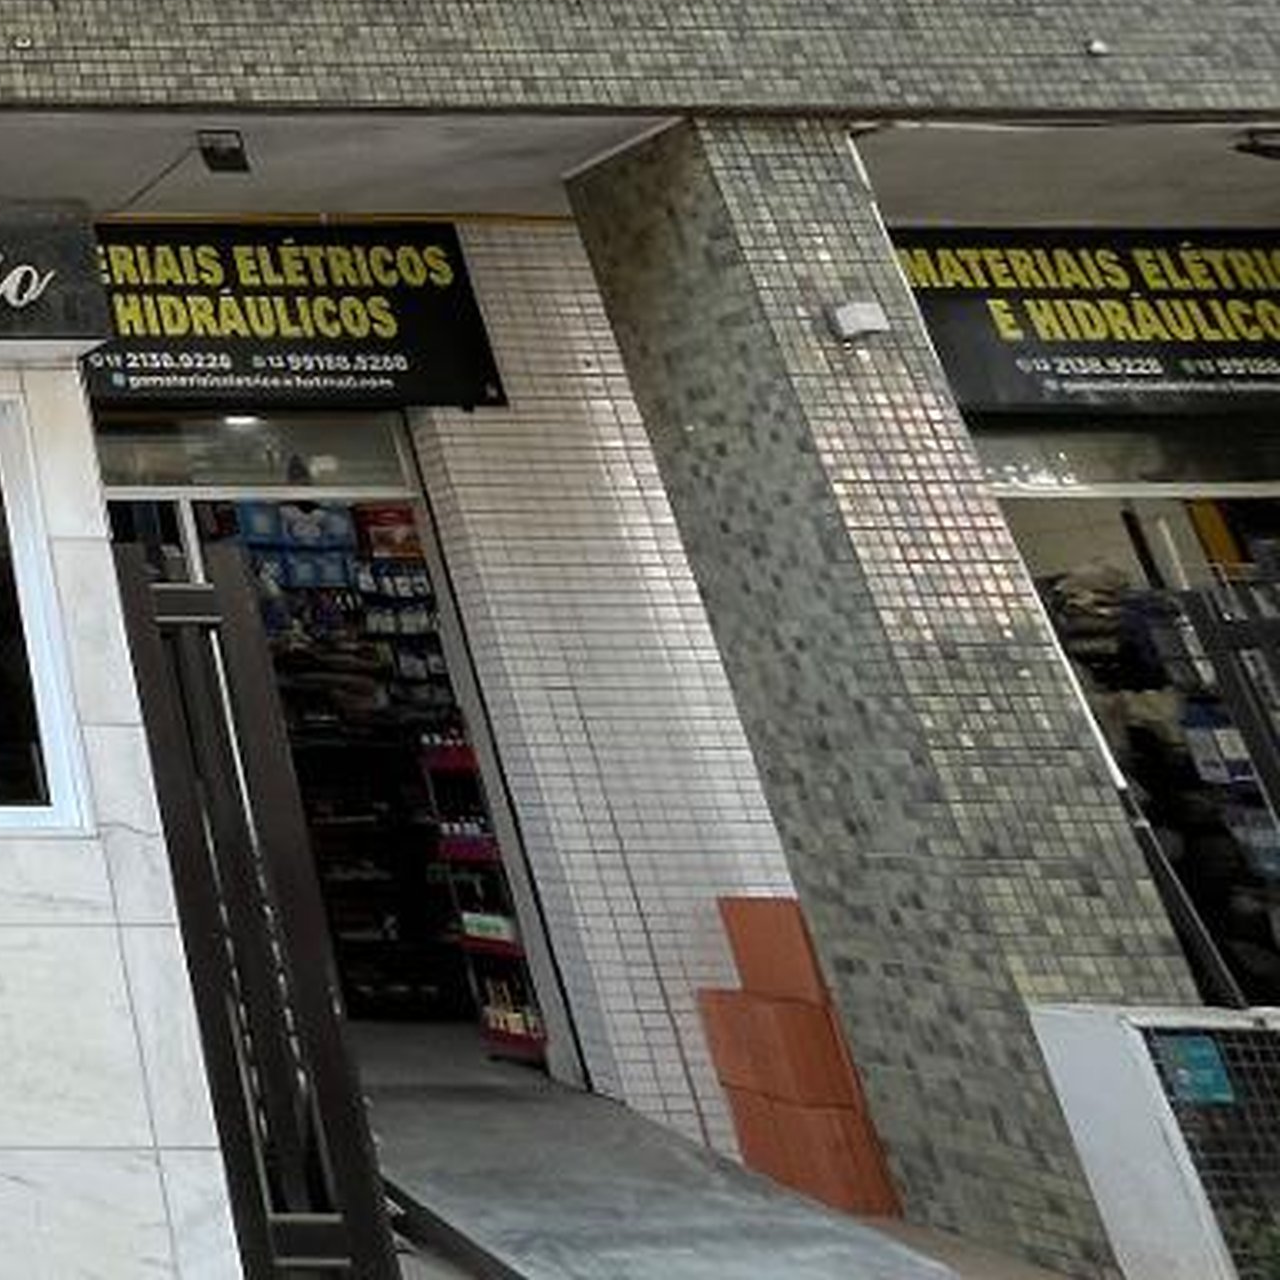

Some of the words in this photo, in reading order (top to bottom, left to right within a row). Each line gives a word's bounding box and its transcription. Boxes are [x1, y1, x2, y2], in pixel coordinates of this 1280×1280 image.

[232, 238, 454, 287] ELÉTRICOS
[901, 249, 1131, 289] MATERIAIS
[114, 288, 398, 339] HIDRÁULICOS
[987, 300, 1023, 342] E
